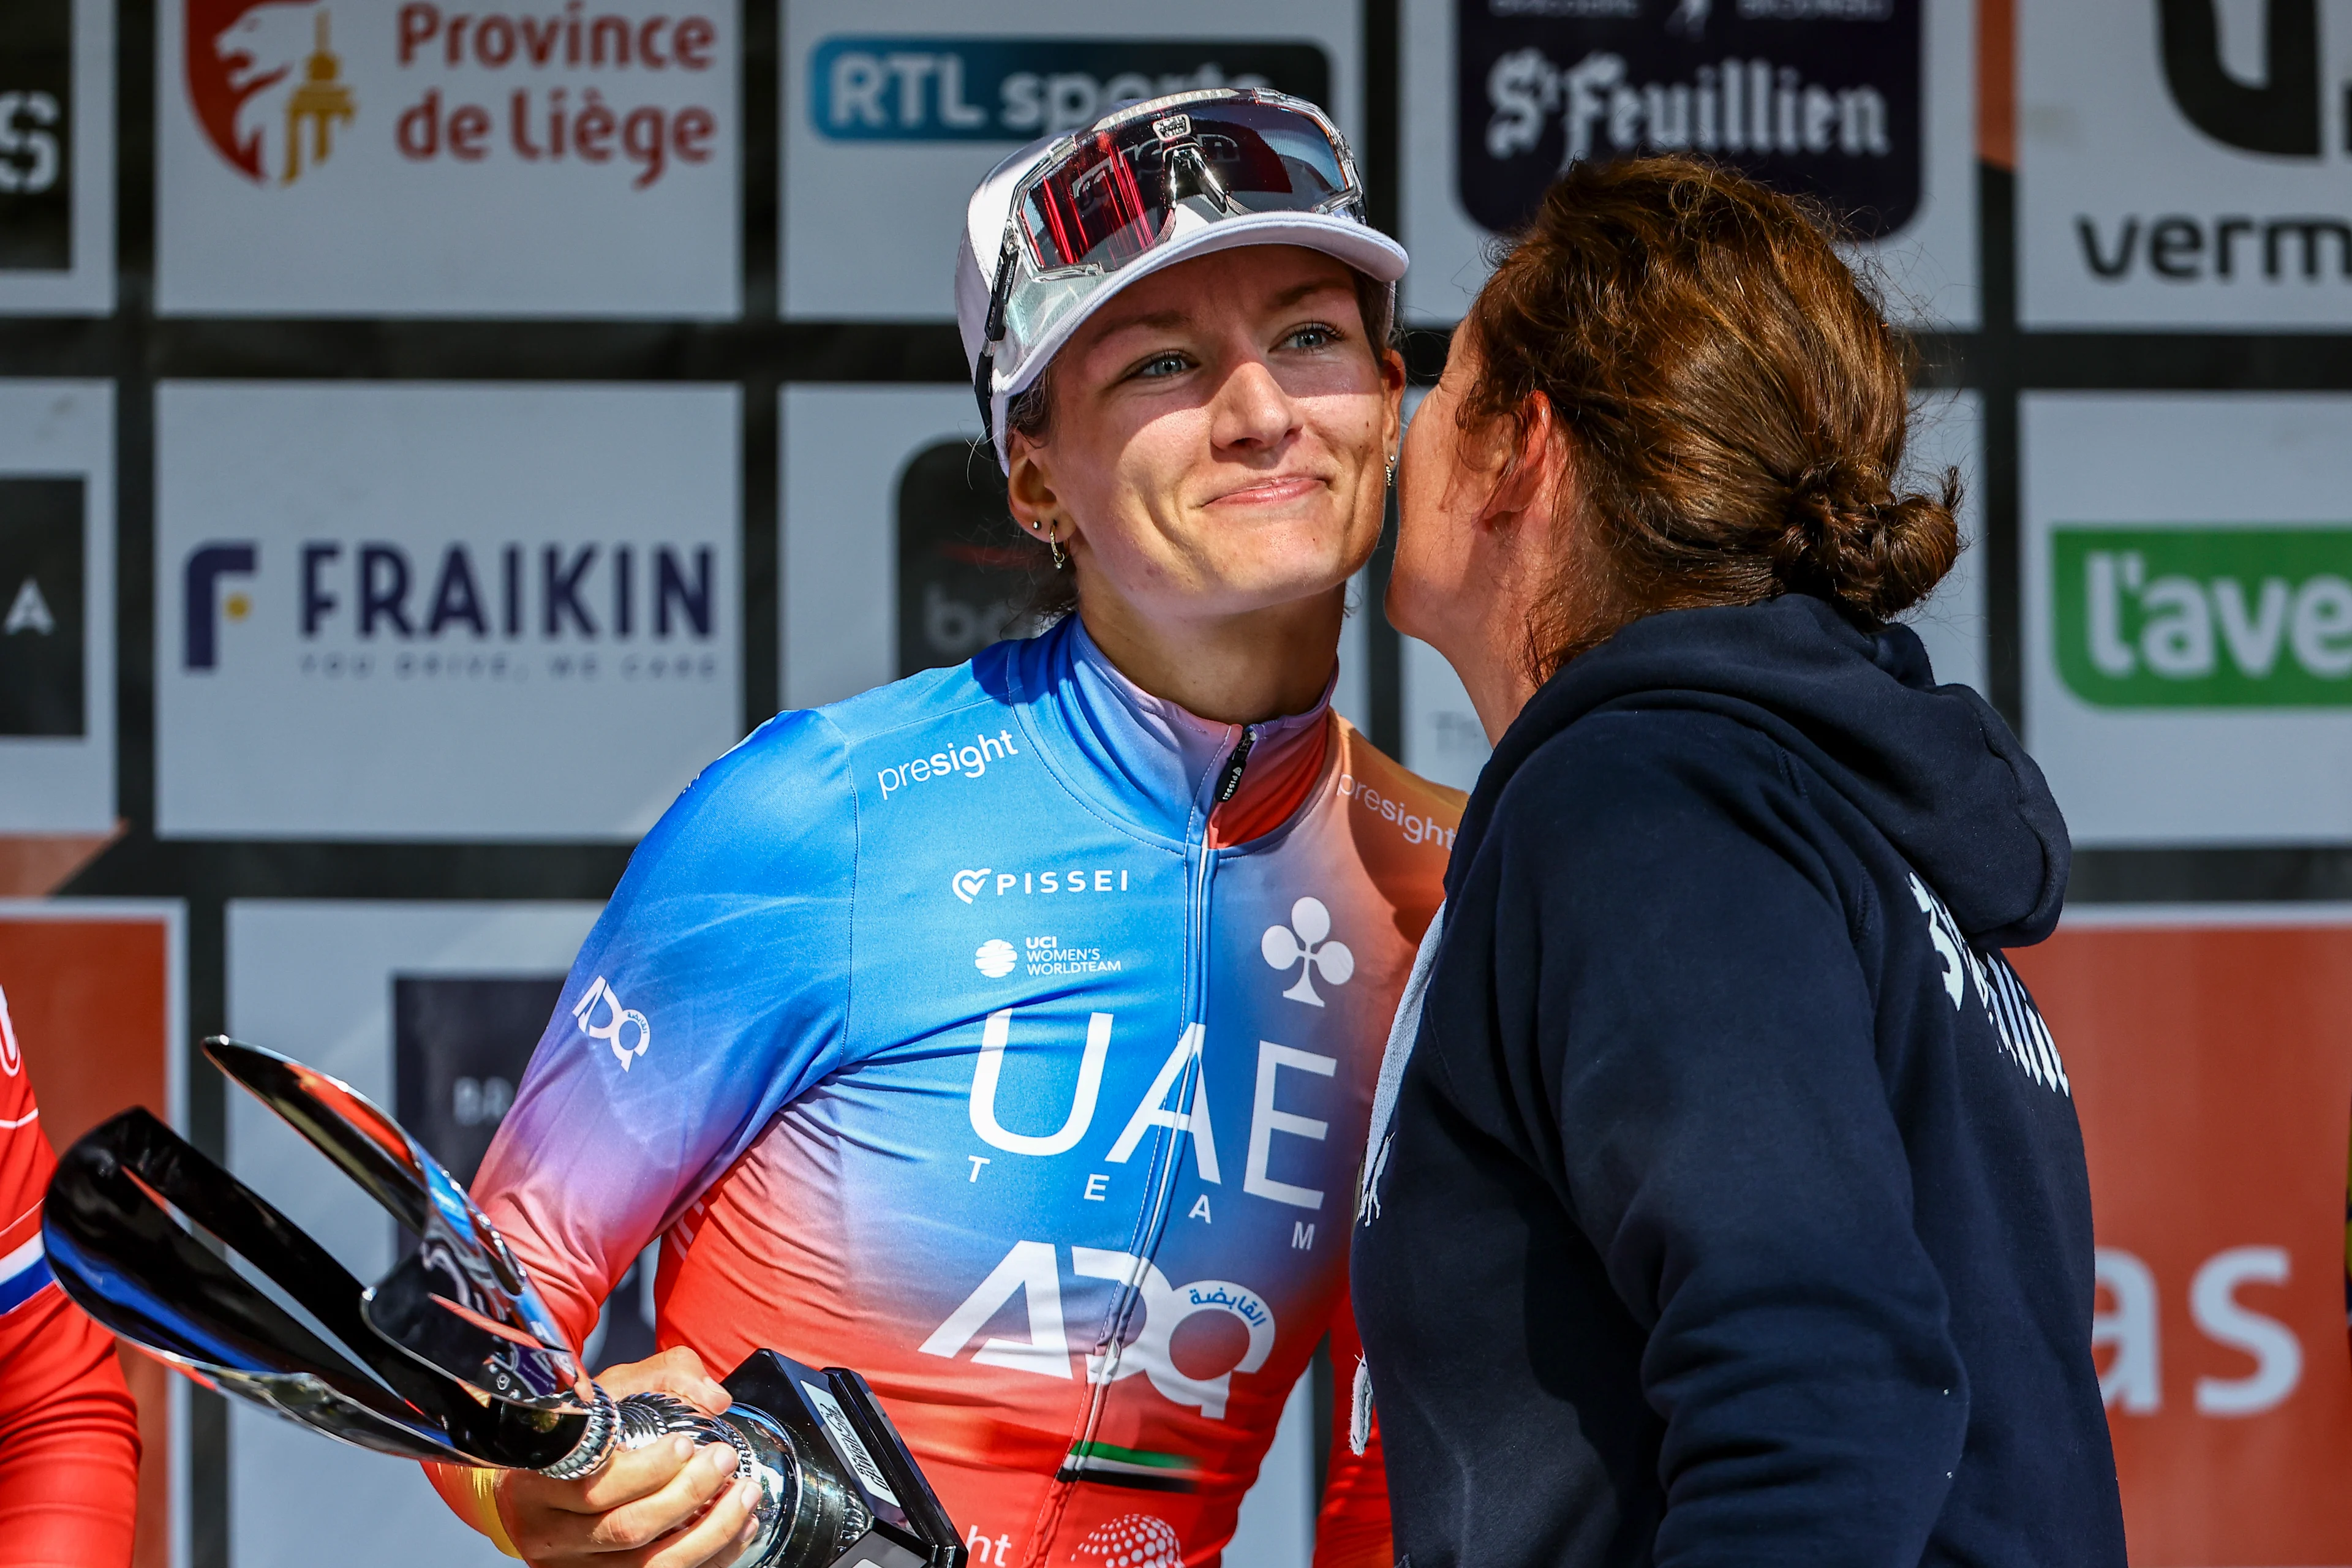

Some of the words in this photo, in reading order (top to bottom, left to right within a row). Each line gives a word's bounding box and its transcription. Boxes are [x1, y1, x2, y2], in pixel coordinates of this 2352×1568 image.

[397, 0, 717, 70] Province
[828, 51, 987, 129] RTL
[998, 64, 1276, 136] spo
[395, 88, 492, 163] de
[510, 87, 717, 191] Liège
[298, 540, 718, 641] FRAIKIN
[878, 729, 1019, 801] presight
[1336, 774, 1457, 851] presight
[996, 870, 1128, 895] PISSEI
[1025, 937, 1058, 949] UCI
[1027, 948, 1101, 962] WOMEN'S
[1027, 960, 1121, 976] WORLDTEAM
[969, 1008, 1337, 1210] UAE
[1189, 1287, 1267, 1327] القابضة
